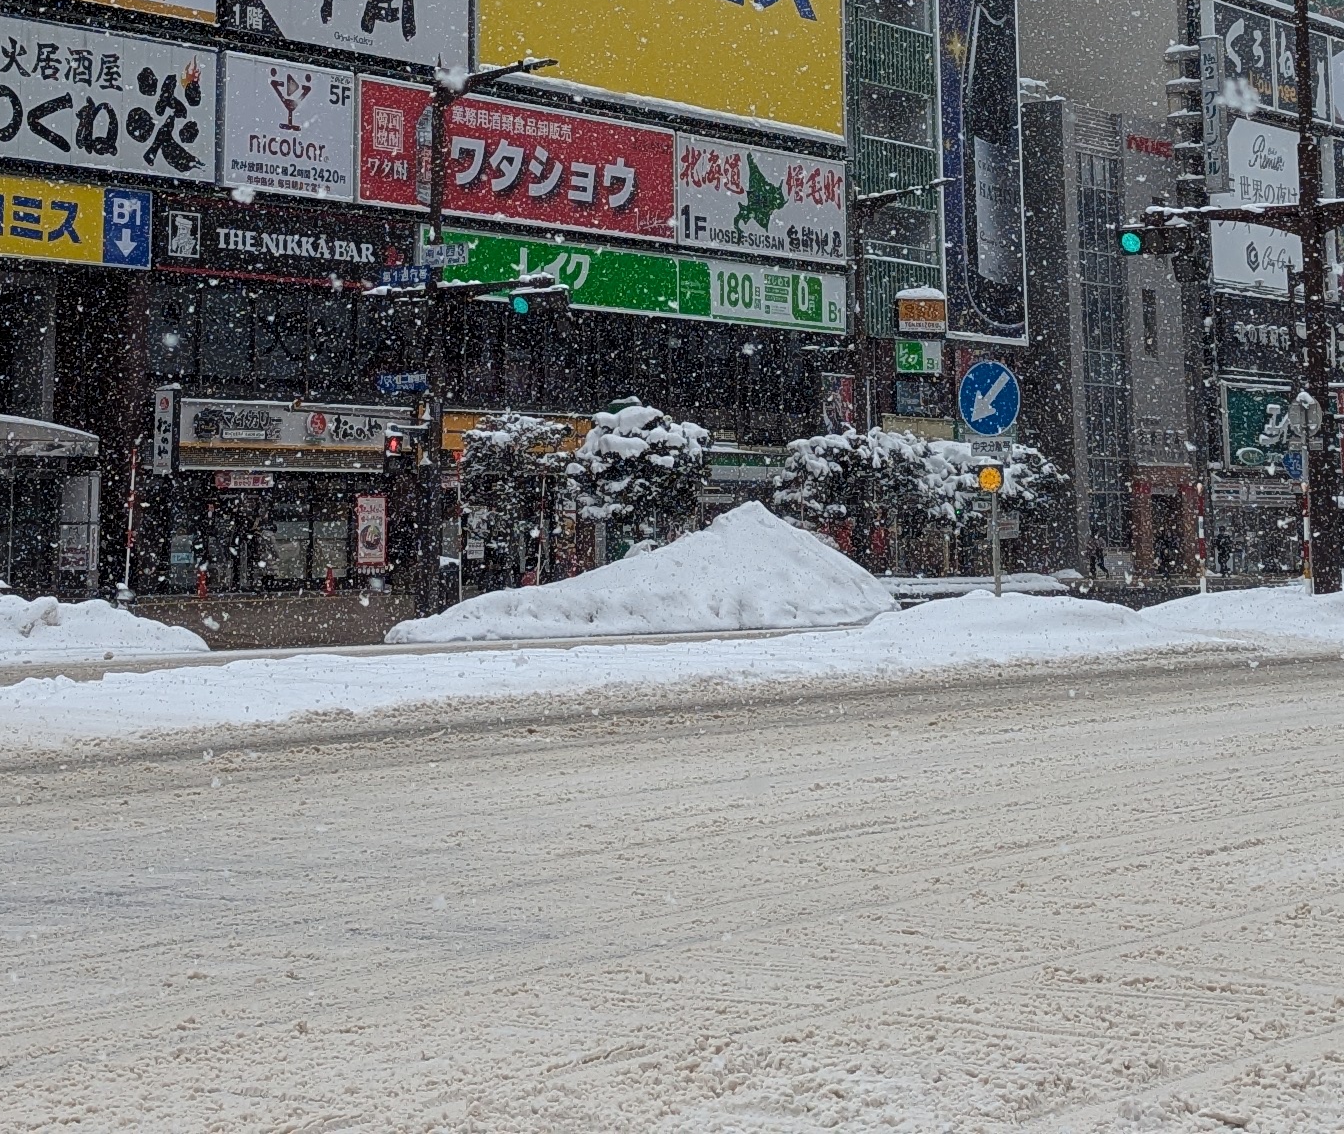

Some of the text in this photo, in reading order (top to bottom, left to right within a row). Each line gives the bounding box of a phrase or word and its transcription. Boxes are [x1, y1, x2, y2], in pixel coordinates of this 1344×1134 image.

[232, 4, 264, 31] 1階
[328, 83, 352, 107] 5F
[451, 106, 573, 143] 業務用酒類食品卸販売
[367, 157, 409, 181] ワタ酎
[451, 135, 637, 209] ワタショウ
[679, 144, 745, 195] 北海道
[785, 164, 844, 211] 増毛町
[112, 196, 142, 226] B1
[681, 204, 708, 241] 1F
[215, 227, 376, 264] THE NIKKA BAR
[716, 270, 754, 309] 180
[828, 301, 843, 324] B1
[331, 414, 384, 440] 松のや
